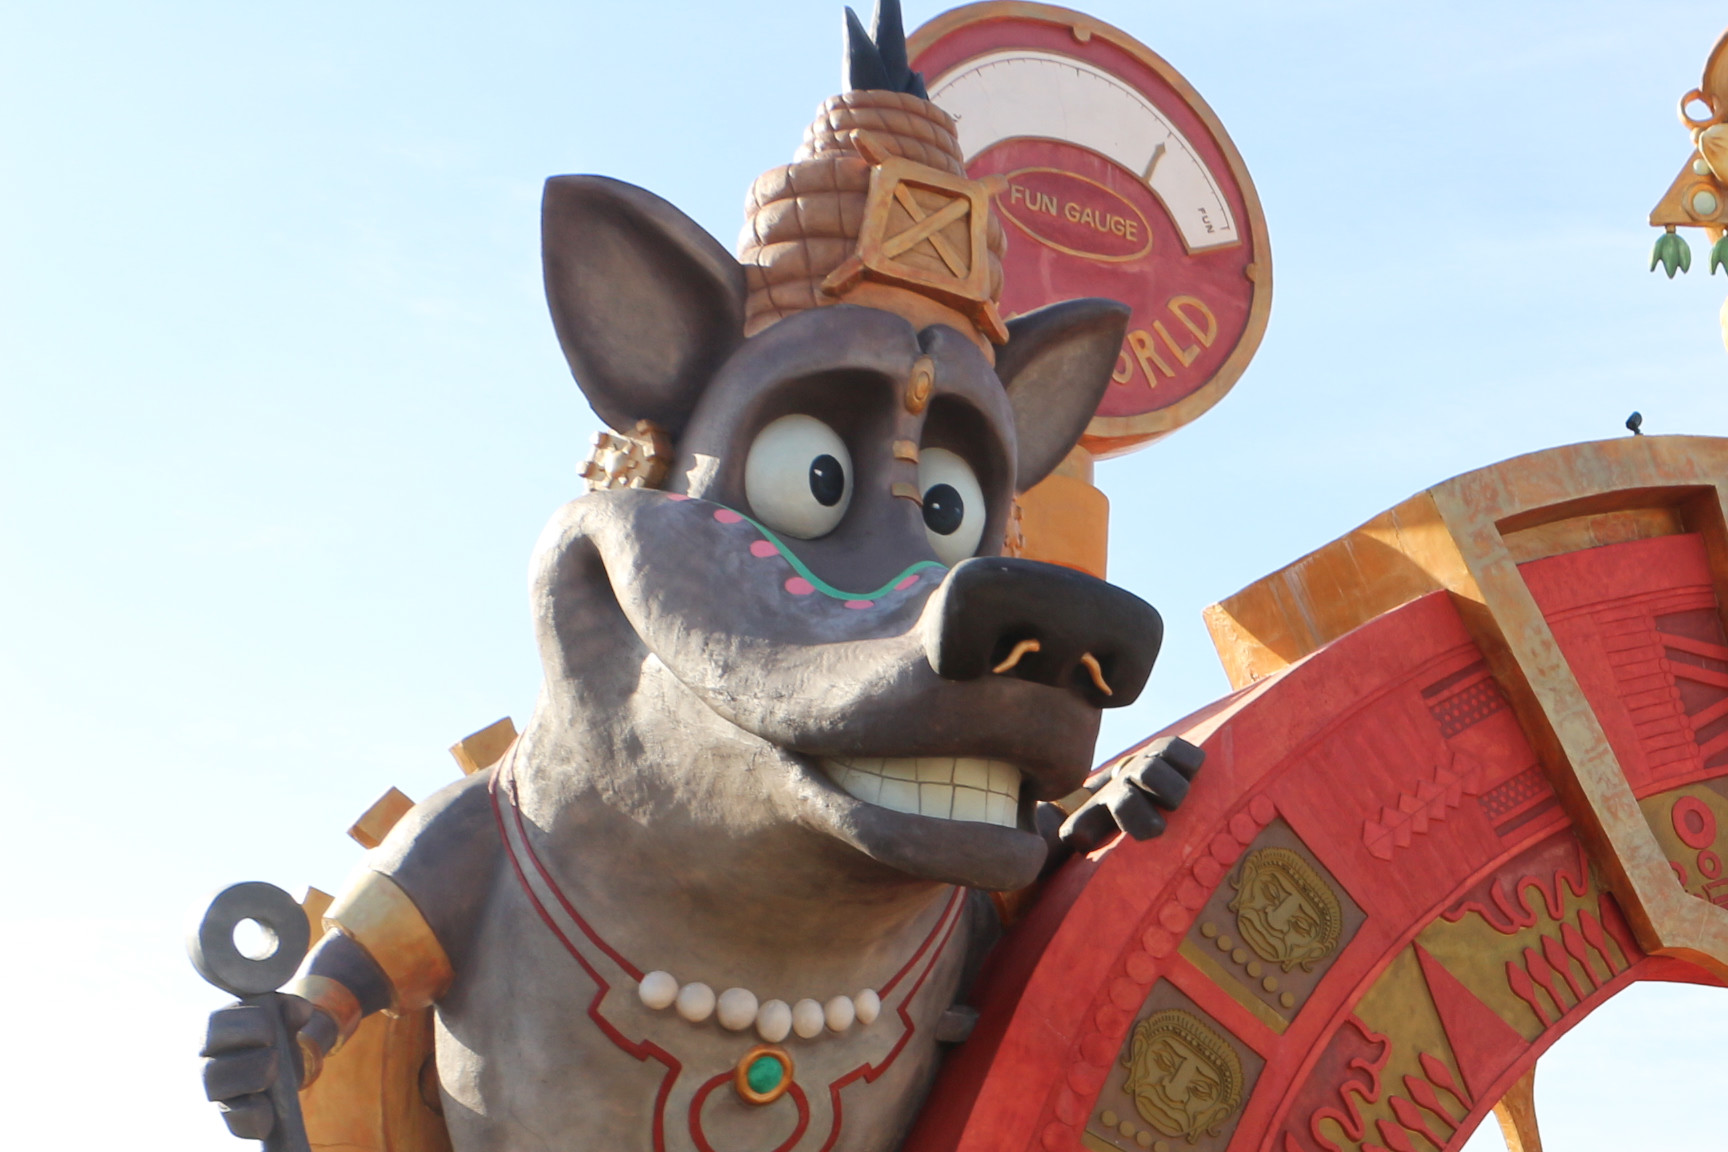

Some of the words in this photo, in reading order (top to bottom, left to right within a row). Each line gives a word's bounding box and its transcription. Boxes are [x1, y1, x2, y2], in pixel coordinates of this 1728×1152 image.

[1011, 185, 1058, 215] FUN
[1065, 202, 1139, 241] GAUGE
[1198, 207, 1215, 234] FUN
[1112, 294, 1218, 389] ORLD
